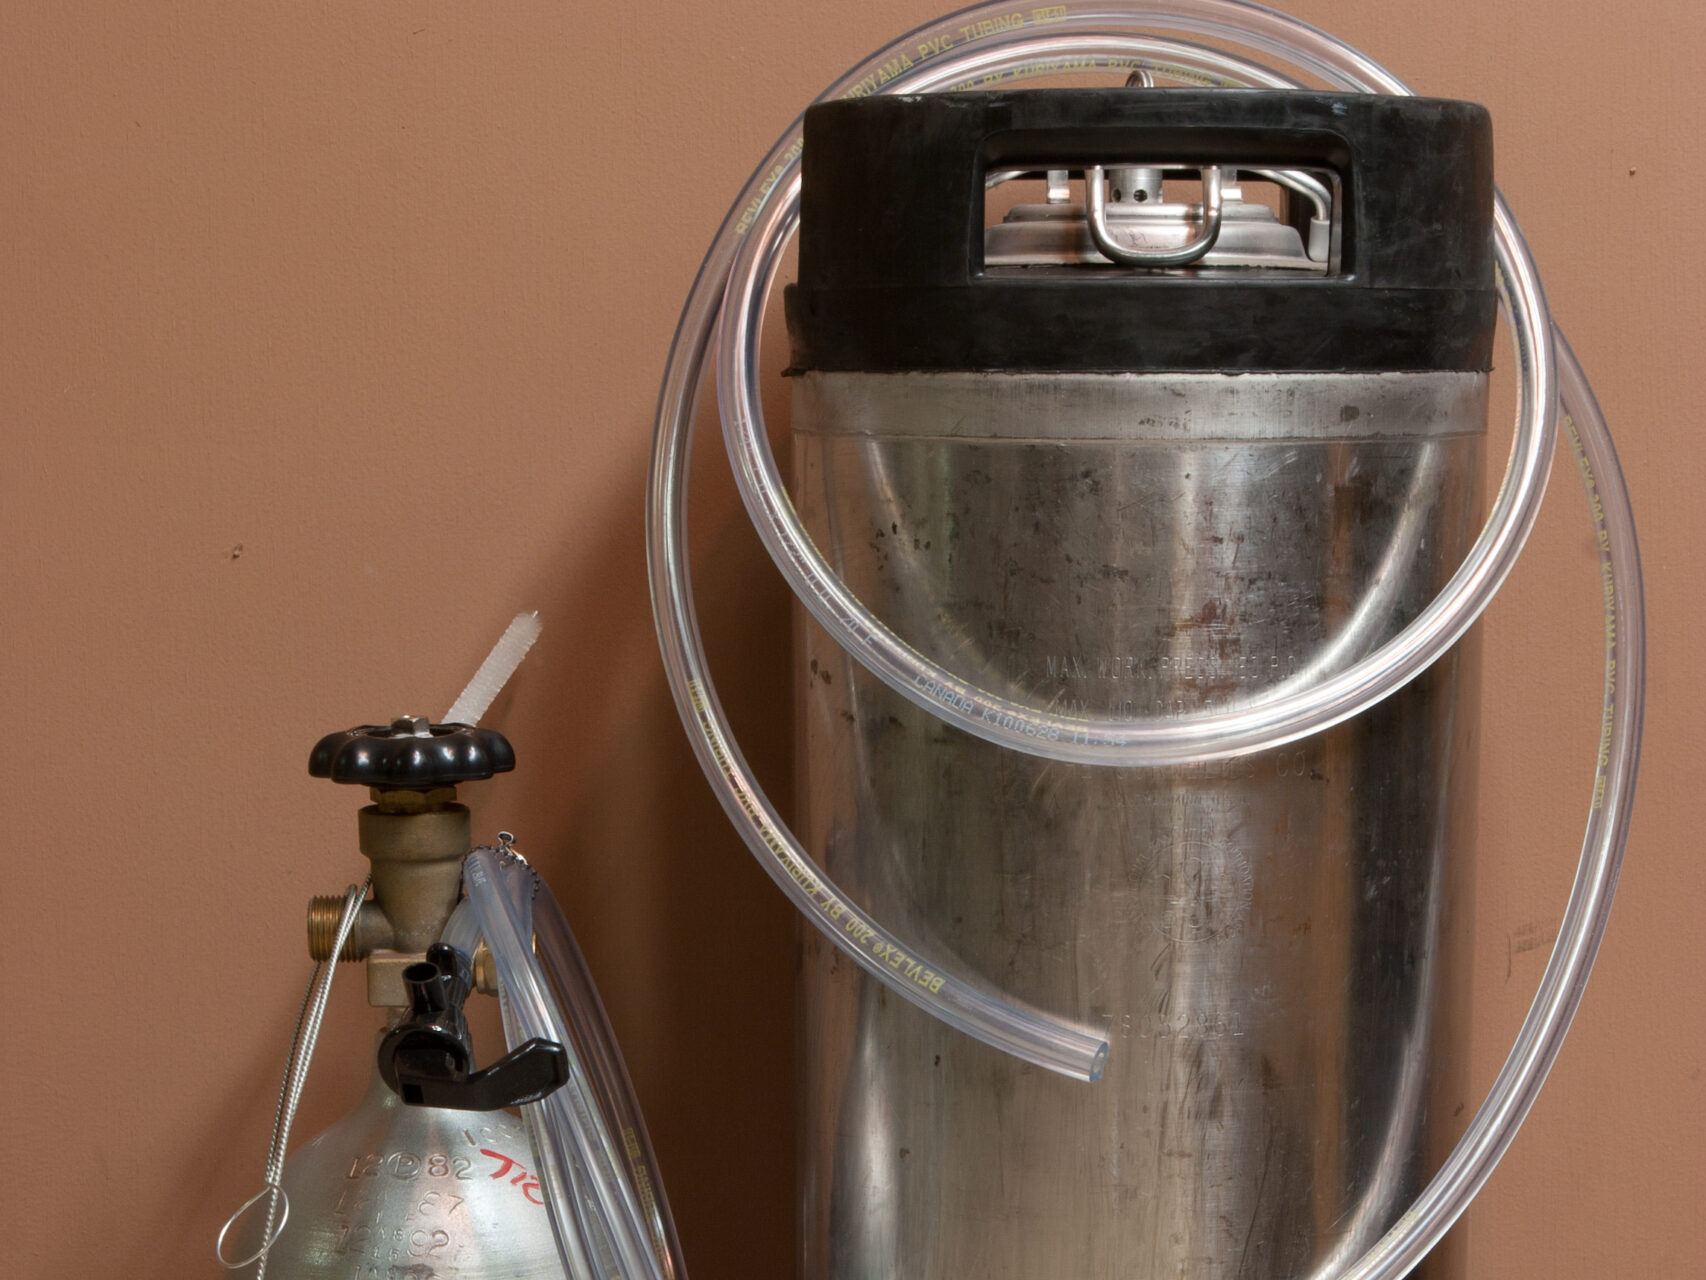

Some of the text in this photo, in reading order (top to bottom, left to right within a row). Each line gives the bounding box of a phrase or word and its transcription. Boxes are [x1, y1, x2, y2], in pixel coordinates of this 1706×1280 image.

[917, 34, 953, 60] PVC
[960, 13, 1024, 42] TUBING
[915, 674, 973, 713] CANADA
[845, 917, 876, 943] 200
